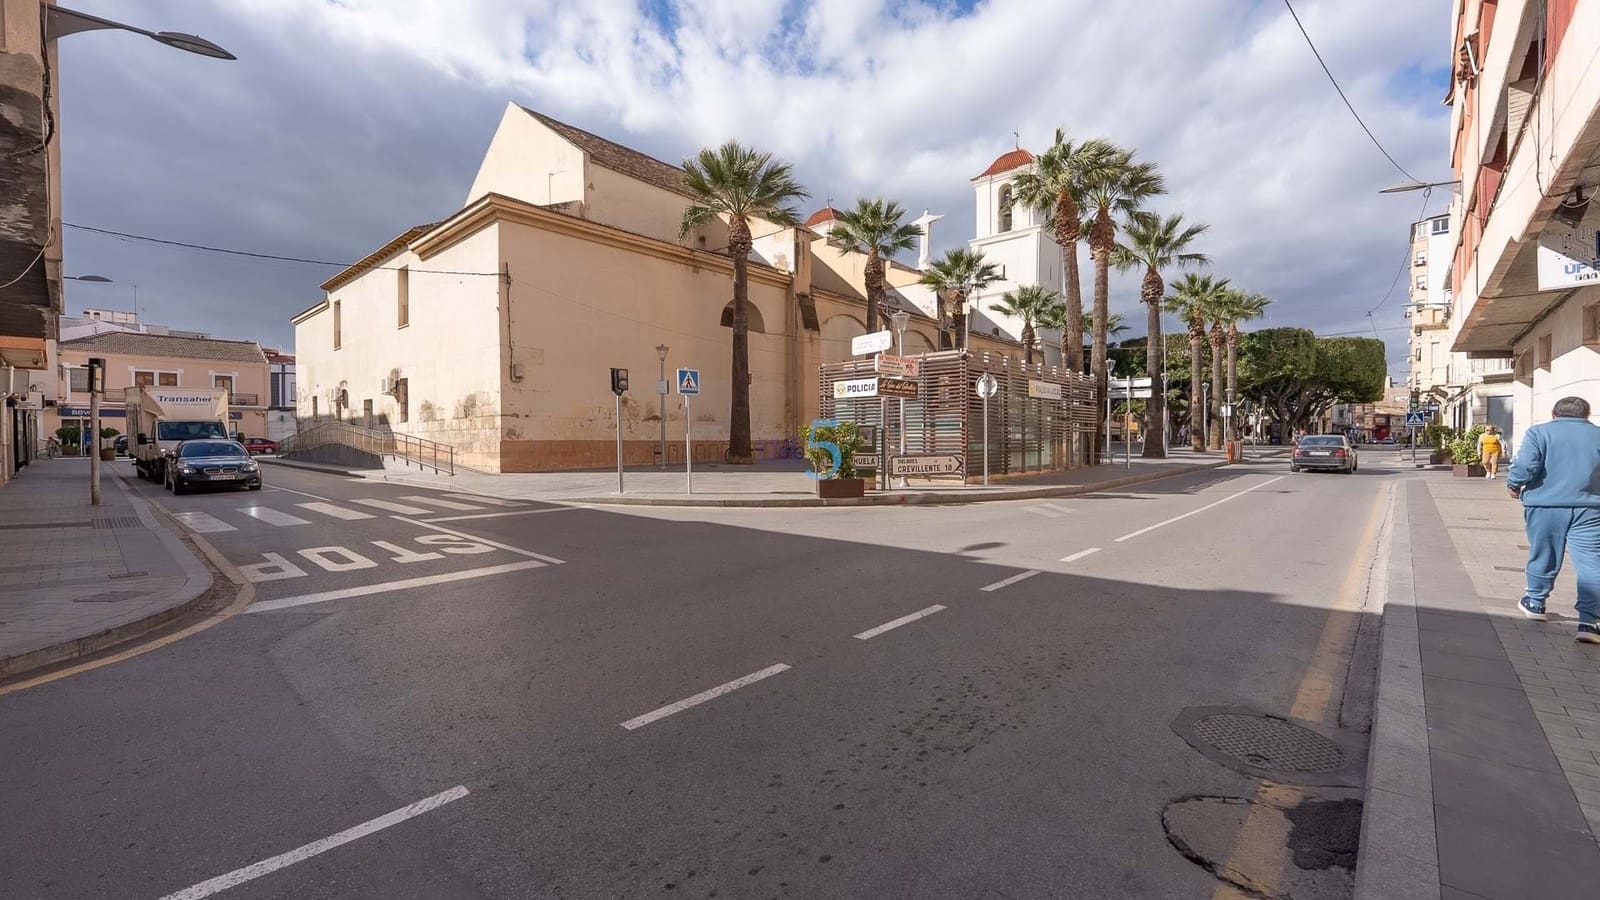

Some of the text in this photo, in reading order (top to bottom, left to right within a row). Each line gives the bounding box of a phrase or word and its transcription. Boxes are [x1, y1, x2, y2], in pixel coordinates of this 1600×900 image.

[847, 382, 876, 393] POLICIA
[157, 394, 213, 403] Transaher
[853, 457, 875, 465] HUELA
[897, 464, 941, 473] CREVILLENTE
[238, 533, 497, 583] STOP
